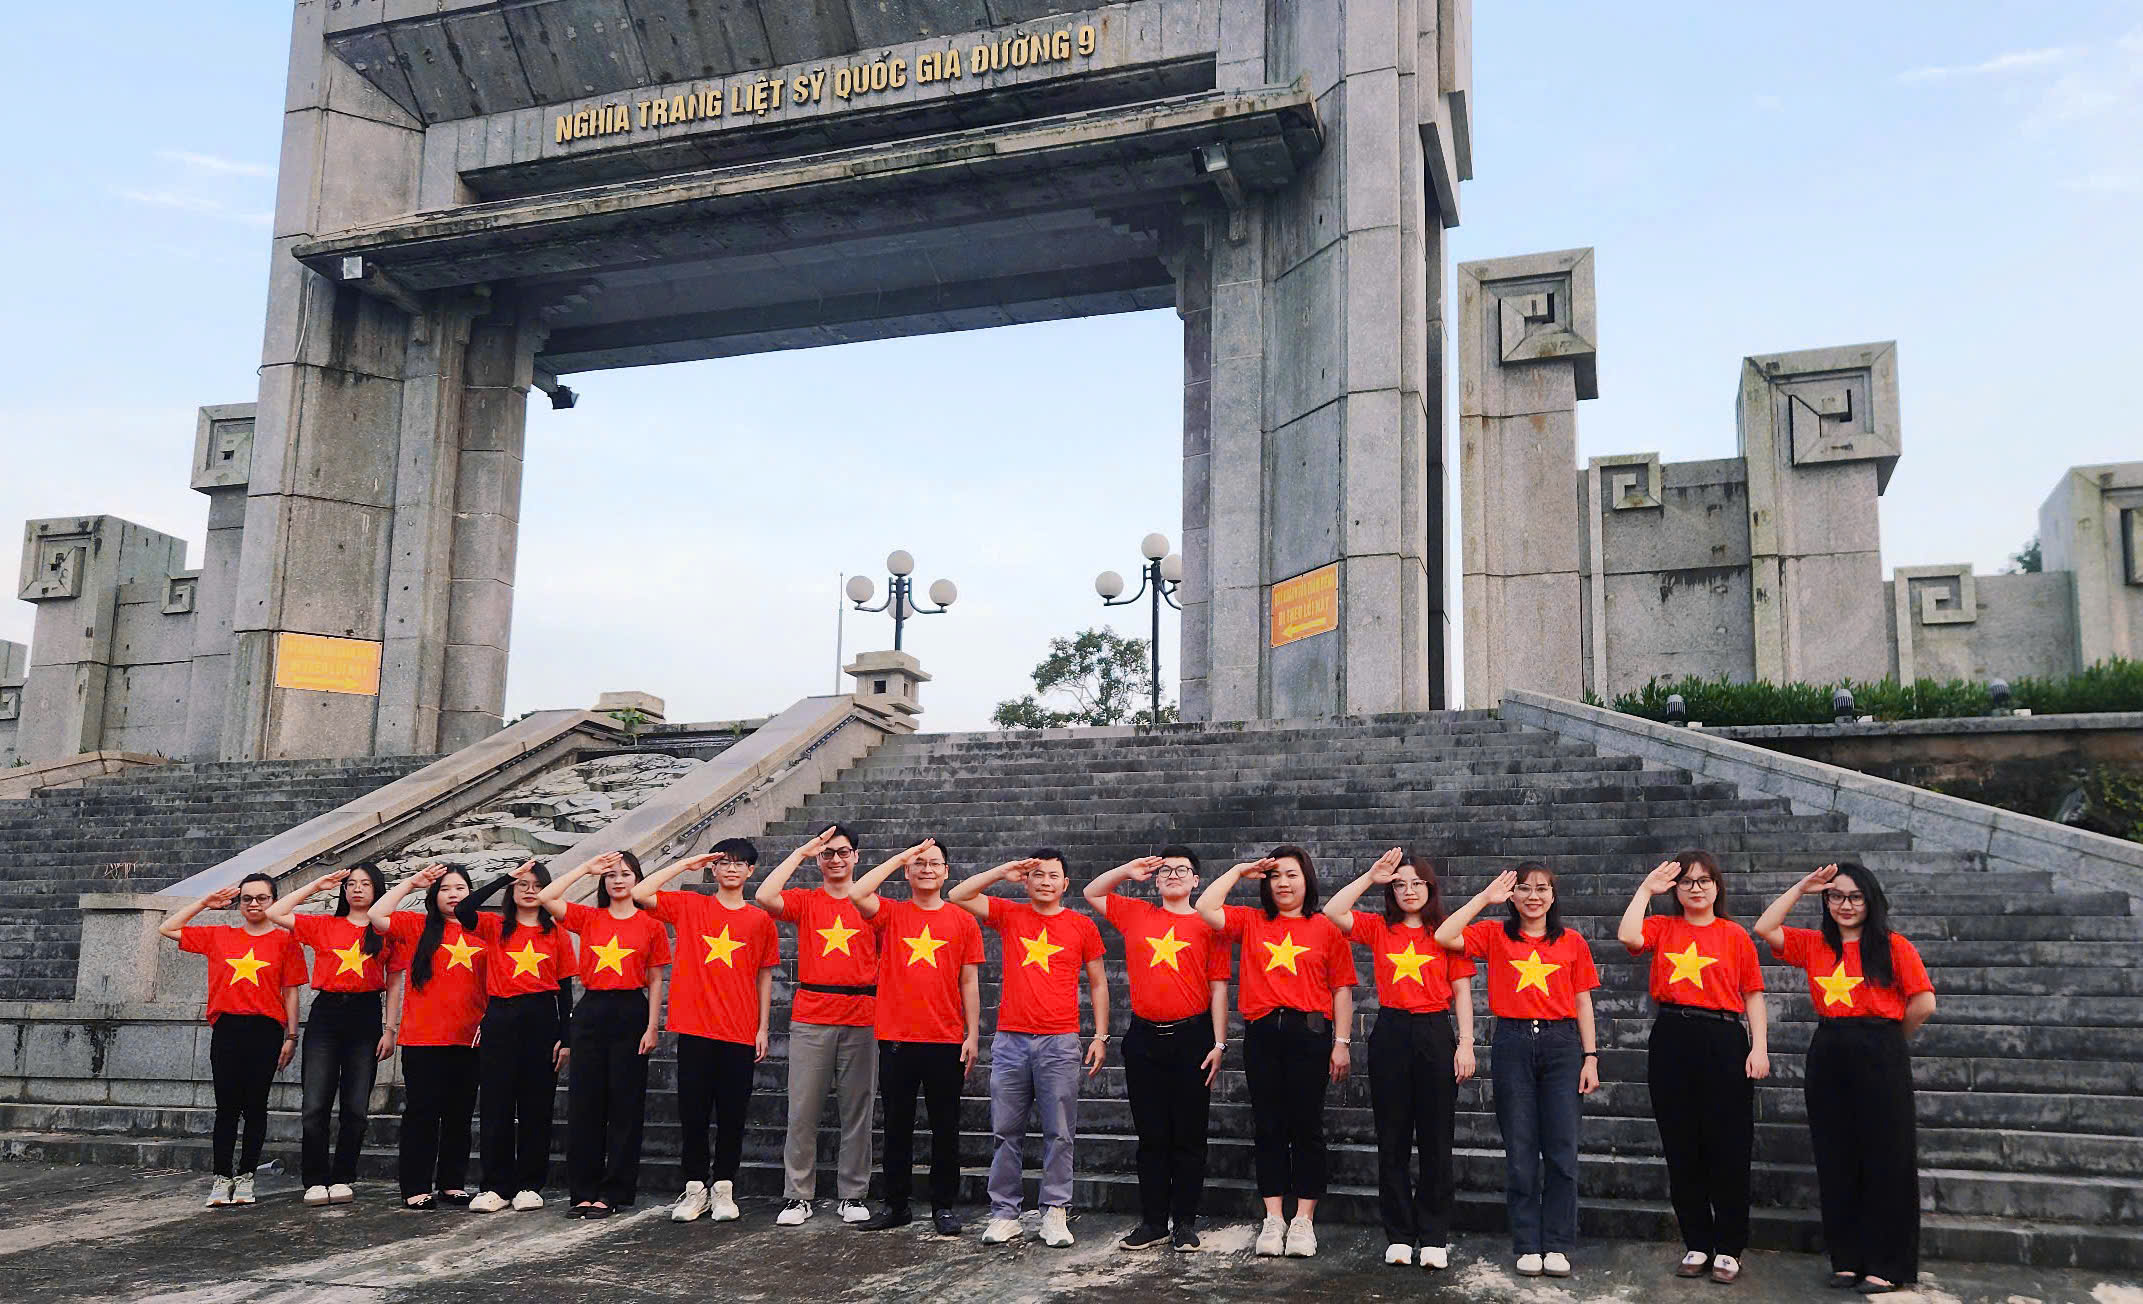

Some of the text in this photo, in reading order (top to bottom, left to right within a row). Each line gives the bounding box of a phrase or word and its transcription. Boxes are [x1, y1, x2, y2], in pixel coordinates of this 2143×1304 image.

[556, 25, 1096, 143] NGHĨA TRANG LIỆT SỸ QUỐC GIA ĐƯỜNG 9
